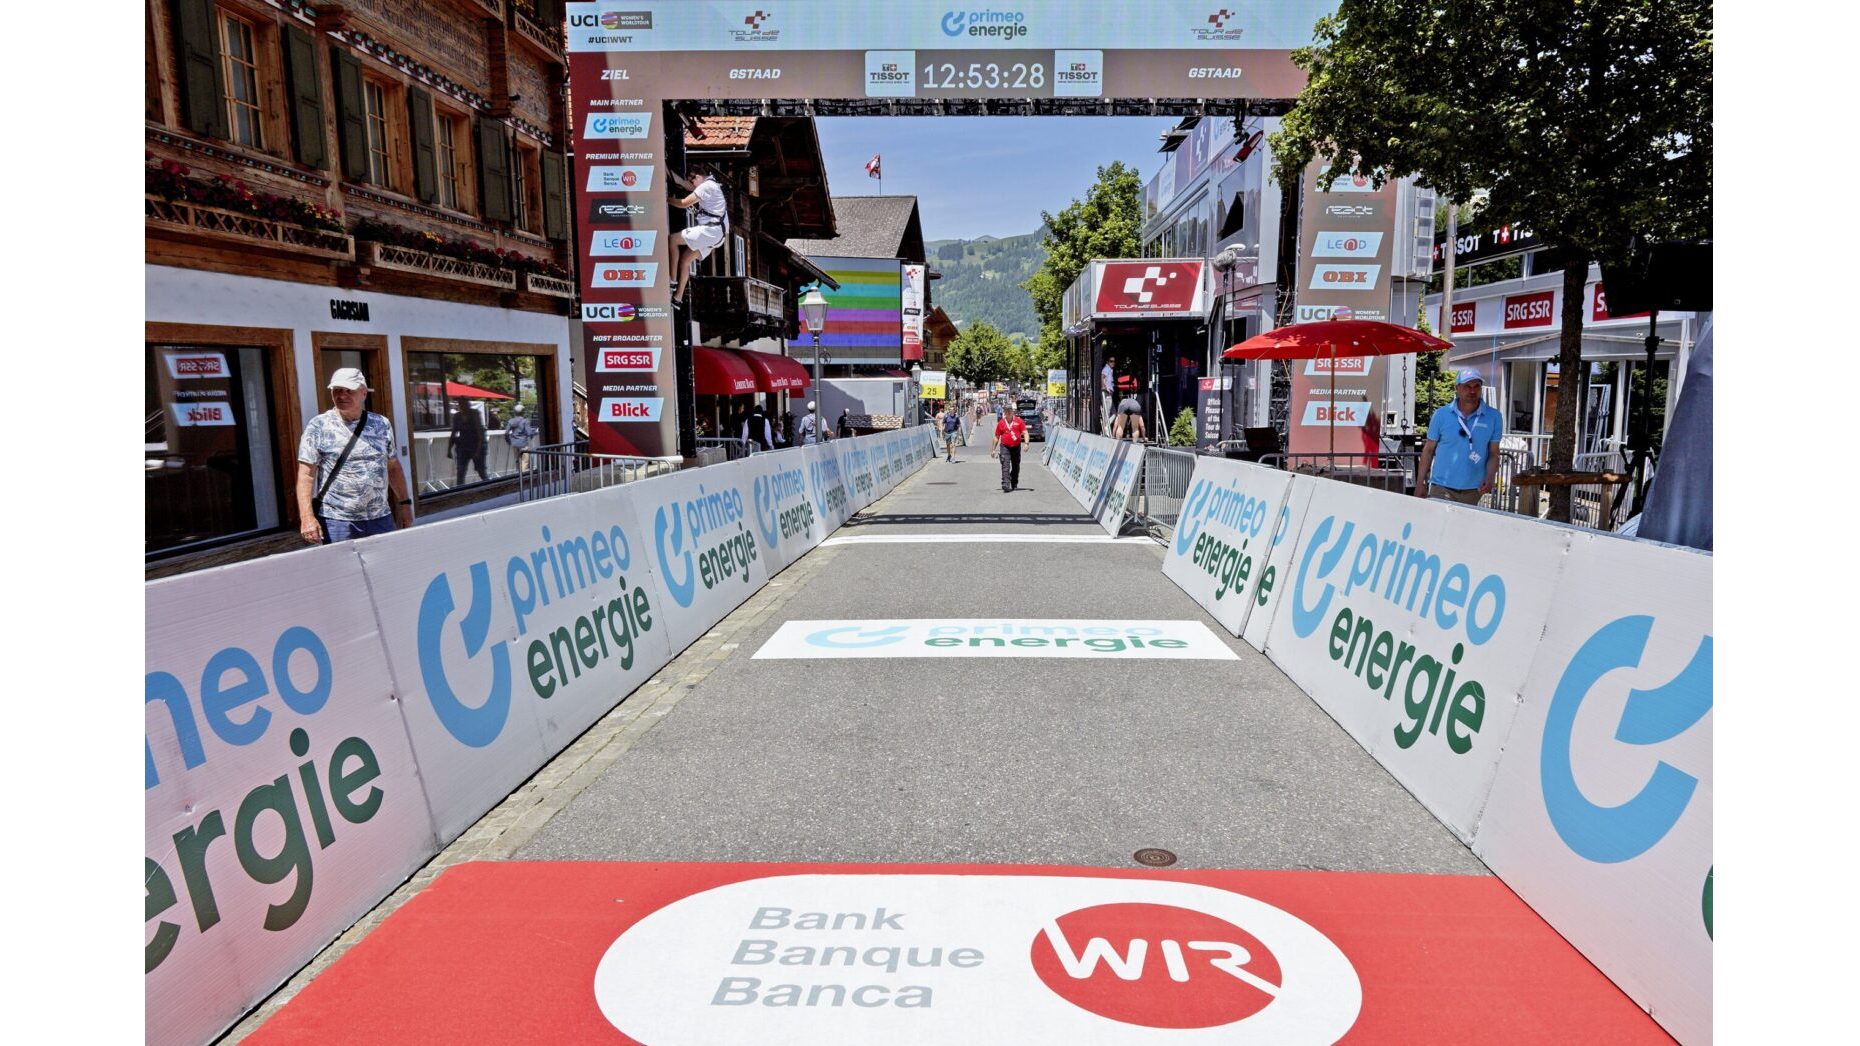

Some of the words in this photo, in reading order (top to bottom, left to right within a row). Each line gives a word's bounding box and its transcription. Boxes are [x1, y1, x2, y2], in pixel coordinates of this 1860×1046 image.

[570, 15, 599, 27] UCI
[969, 9, 1024, 24] primeo
[969, 22, 1028, 40] energie
[587, 36, 633, 44] #UCIWWT
[600, 69, 630, 80] ZIEL
[729, 68, 781, 79] GSTAAD
[870, 72, 910, 80] TISSOT
[922, 63, 1045, 89] 12:53:28
[1058, 72, 1099, 80] TISSOT
[1188, 67, 1242, 78] GSTAAD
[608, 118, 641, 128] primeo
[608, 126, 643, 136] energie
[603, 269, 647, 281] OBI
[1322, 271, 1368, 283] OBI
[586, 306, 615, 319] UCI
[1300, 308, 1331, 320] UCI
[1457, 310, 1474, 326] SSR
[1507, 303, 1528, 321] SRG
[1528, 299, 1550, 319] SSR
[607, 355, 628, 365] SRG
[629, 355, 651, 365] SSR
[1340, 358, 1362, 368] SSR
[927, 387, 937, 396] 25
[611, 402, 650, 417] Blick
[772, 463, 806, 510] primeo
[825, 479, 847, 513] energie
[686, 483, 744, 549] primeo
[1204, 478, 1267, 538] primeo
[779, 495, 815, 540] energie
[698, 521, 758, 590] energie
[1192, 531, 1253, 601] energie
[506, 525, 632, 635] primeo
[1344, 522, 1507, 646] primeo
[526, 575, 653, 699] energie
[927, 623, 1163, 638] primeo
[923, 633, 1189, 653] energie
[1328, 606, 1487, 755] energie
[747, 906, 907, 931] Bank
[730, 939, 986, 970] Banque
[1043, 920, 1280, 998] WIR
[709, 976, 934, 1010] Banca
